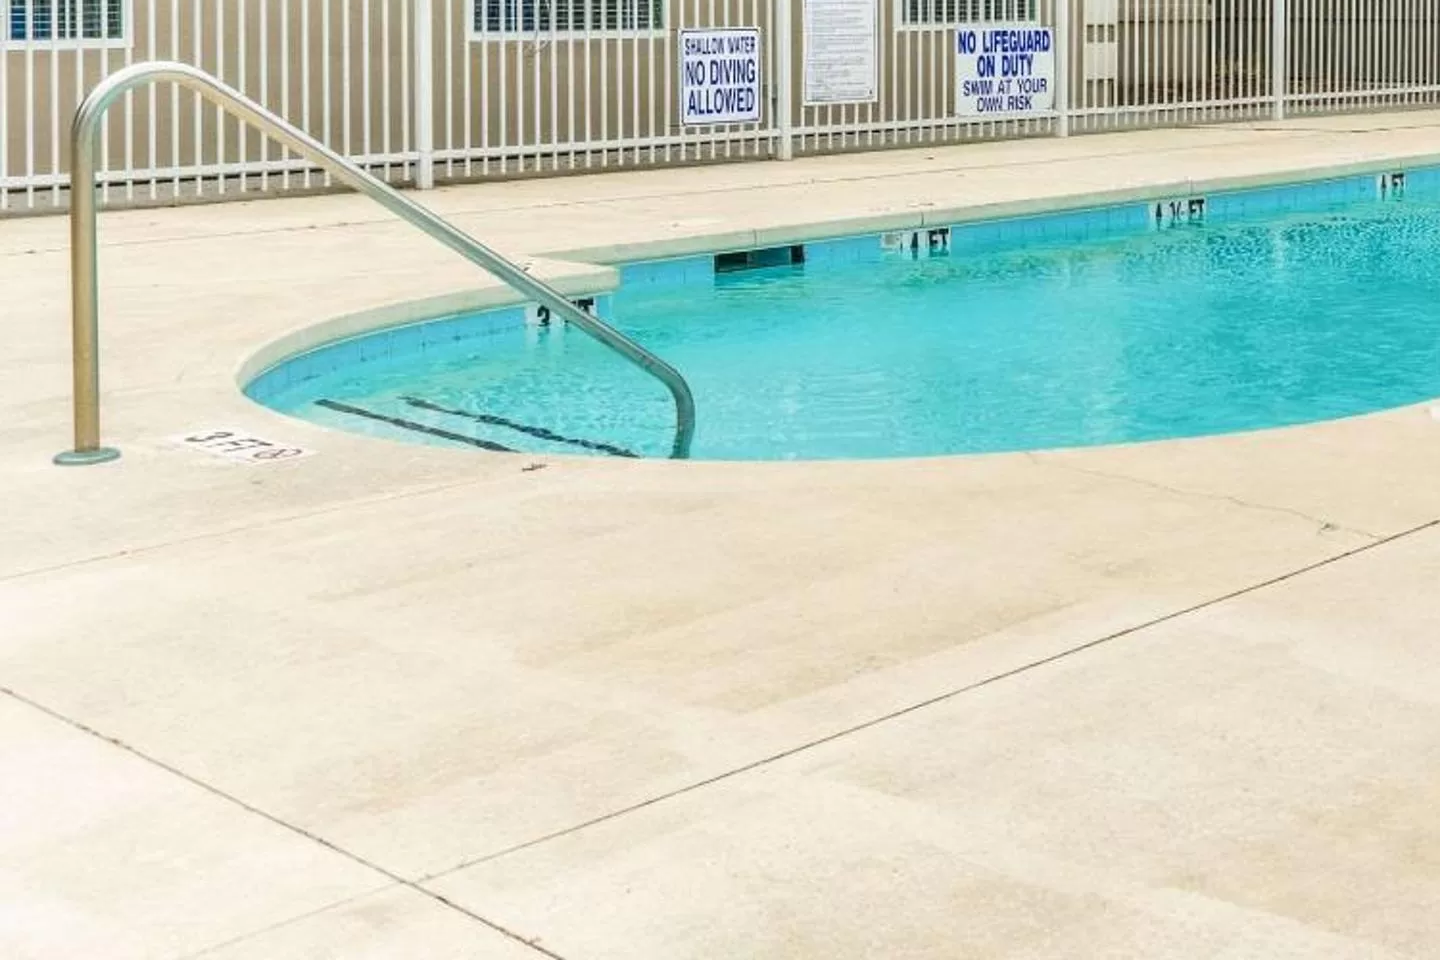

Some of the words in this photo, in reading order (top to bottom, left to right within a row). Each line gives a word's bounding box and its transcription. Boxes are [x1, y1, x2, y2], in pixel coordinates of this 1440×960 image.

[685, 37, 725, 56] SHALLOW
[727, 35, 756, 54] WATER
[958, 30, 976, 54] NO
[982, 29, 1051, 53] LIFEGUARD
[685, 60, 705, 87] NO
[710, 58, 756, 85] DIVING
[977, 54, 996, 78] ON
[1001, 53, 1034, 77] DUTY
[963, 79, 993, 97] SWIM
[998, 79, 1012, 95] AT
[1017, 78, 1048, 94] YOUR
[687, 87, 756, 116] ALLOWED
[976, 97, 1003, 113] OWN
[1007, 95, 1033, 111] RISK
